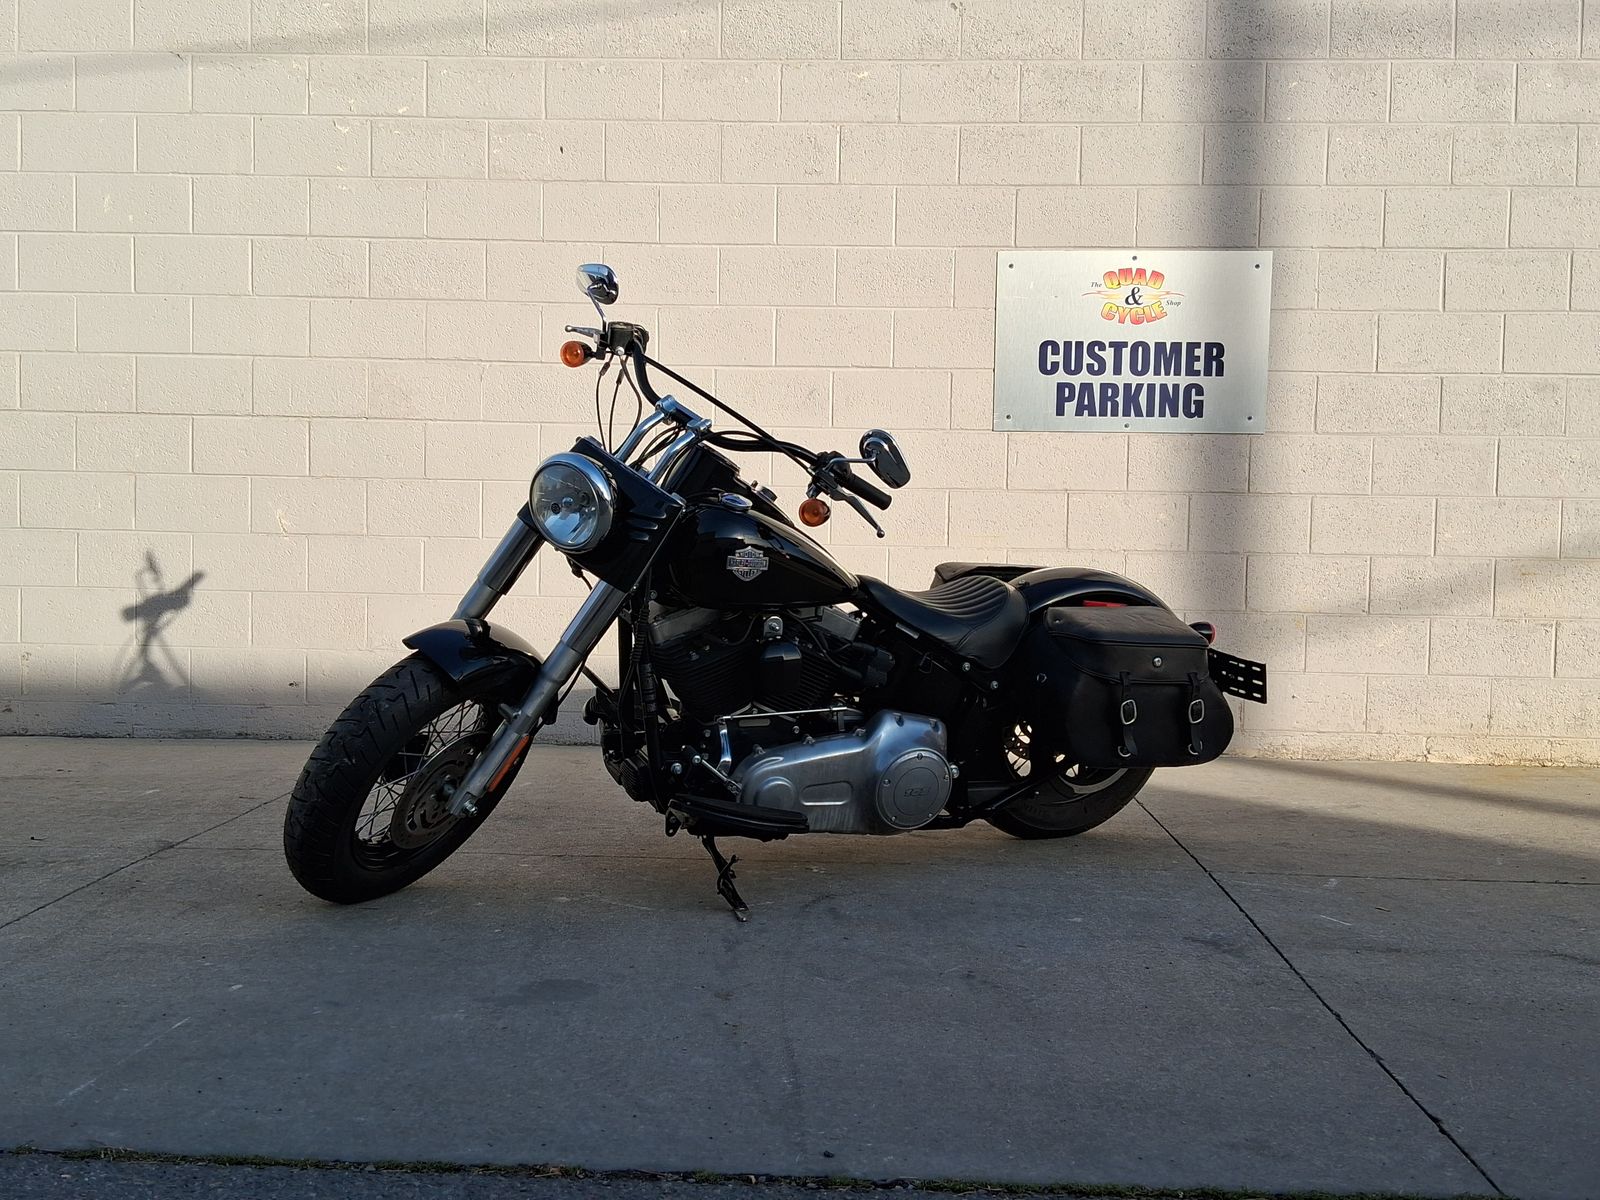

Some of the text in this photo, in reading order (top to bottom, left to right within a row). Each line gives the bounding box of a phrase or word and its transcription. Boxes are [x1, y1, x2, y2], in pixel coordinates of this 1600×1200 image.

[1103, 268, 1165, 290] QUAD
[1125, 286, 1144, 306] &
[1101, 301, 1168, 325] CYCLE
[1038, 340, 1225, 377] CUSTOMER
[1055, 382, 1205, 419] PARKING
